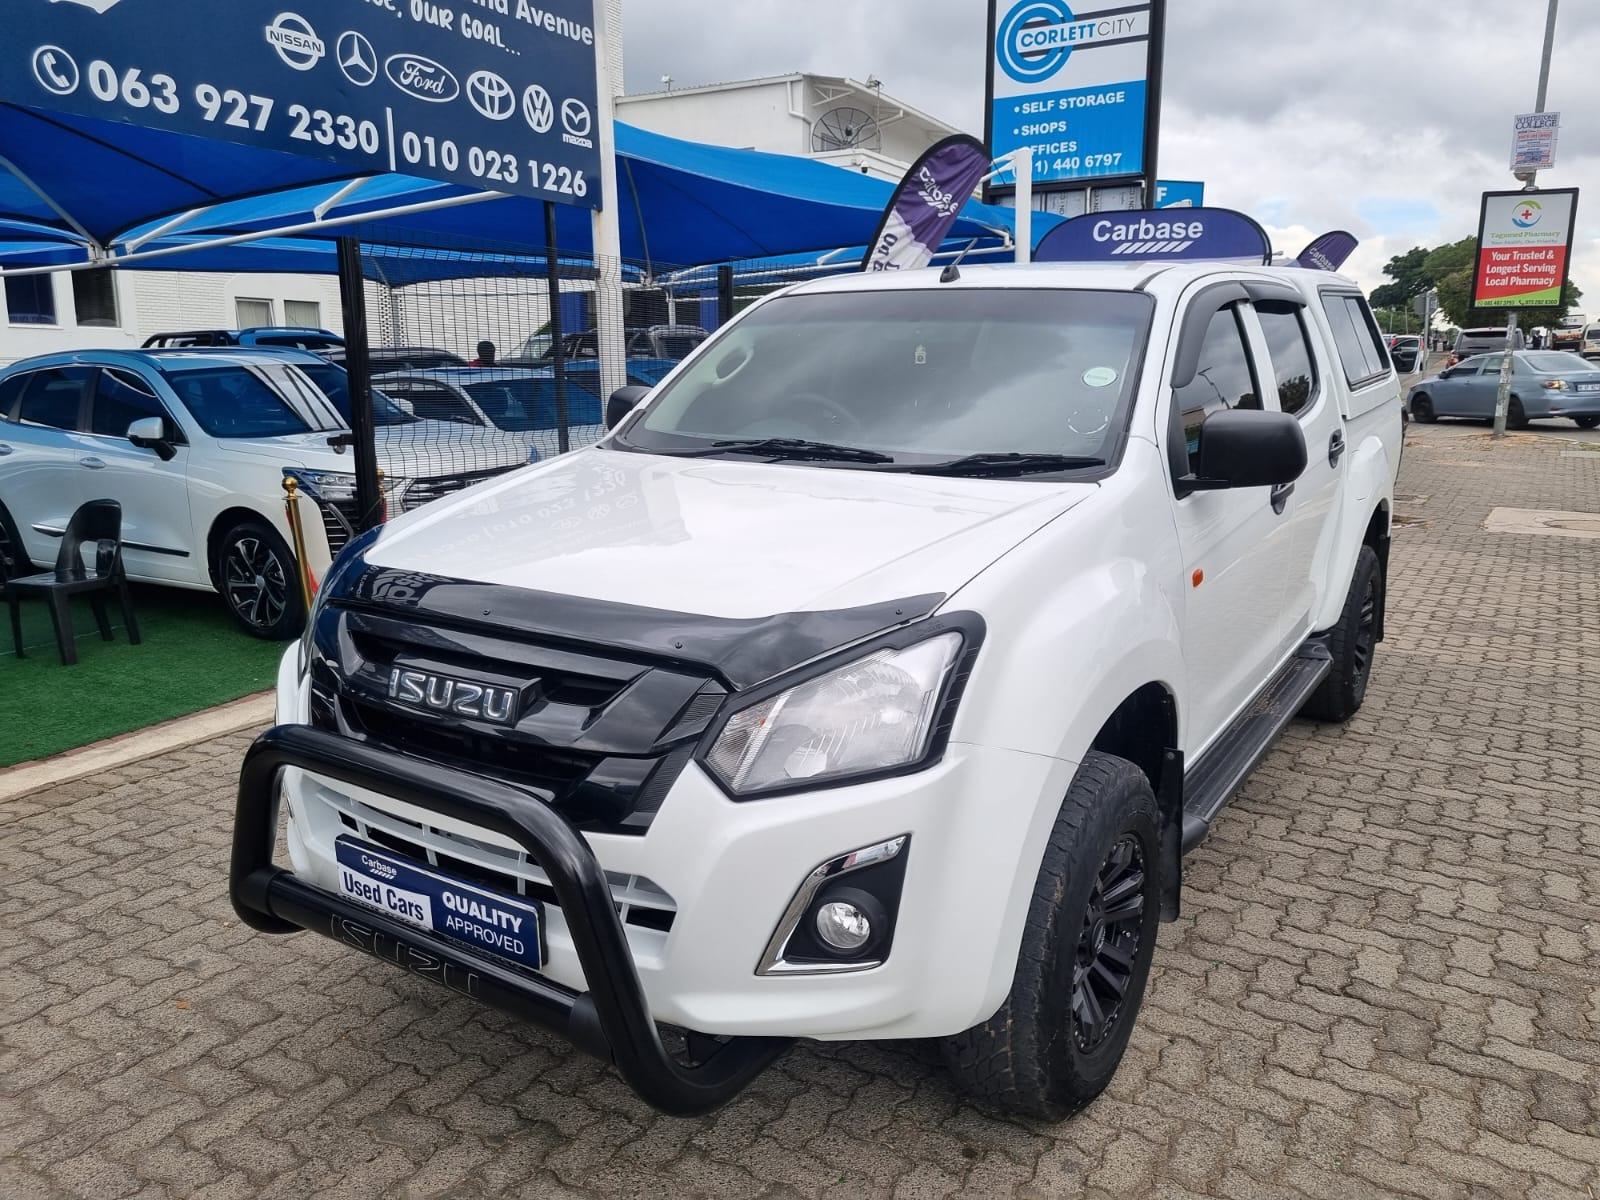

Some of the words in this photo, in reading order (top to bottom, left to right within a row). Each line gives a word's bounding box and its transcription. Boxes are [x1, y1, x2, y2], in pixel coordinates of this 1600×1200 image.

[515, 0, 593, 45] Avenue
[269, 30, 322, 53] NISSAN
[400, 60, 446, 95] Ford
[88, 60, 180, 114] 063
[195, 84, 274, 132] 927
[288, 104, 379, 154] 2330
[1022, 99, 1055, 114] SELF
[1059, 91, 1126, 110] STORAGE
[1021, 121, 1067, 136] SHOPS
[1030, 141, 1078, 156] FFICES
[402, 131, 459, 172] 010
[468, 146, 519, 184] 023
[528, 159, 587, 197] 1226
[1052, 156, 1080, 171] 440
[1084, 152, 1123, 168] 6797
[1092, 218, 1204, 242] Carbase
[1491, 251, 1511, 261] Your
[1513, 249, 1545, 260] Trusted
[1546, 249, 1554, 259] &
[1486, 264, 1520, 275] Longest
[1522, 263, 1557, 275] Serving
[1485, 277, 1508, 286] Local
[1510, 276, 1555, 287] Pharmacy
[388, 668, 513, 722] ISUZU
[361, 855, 398, 876] Carbase
[343, 871, 382, 905] Used
[386, 888, 424, 921] Cars
[441, 891, 523, 934] QUALITY
[446, 915, 525, 955] APPROVED
